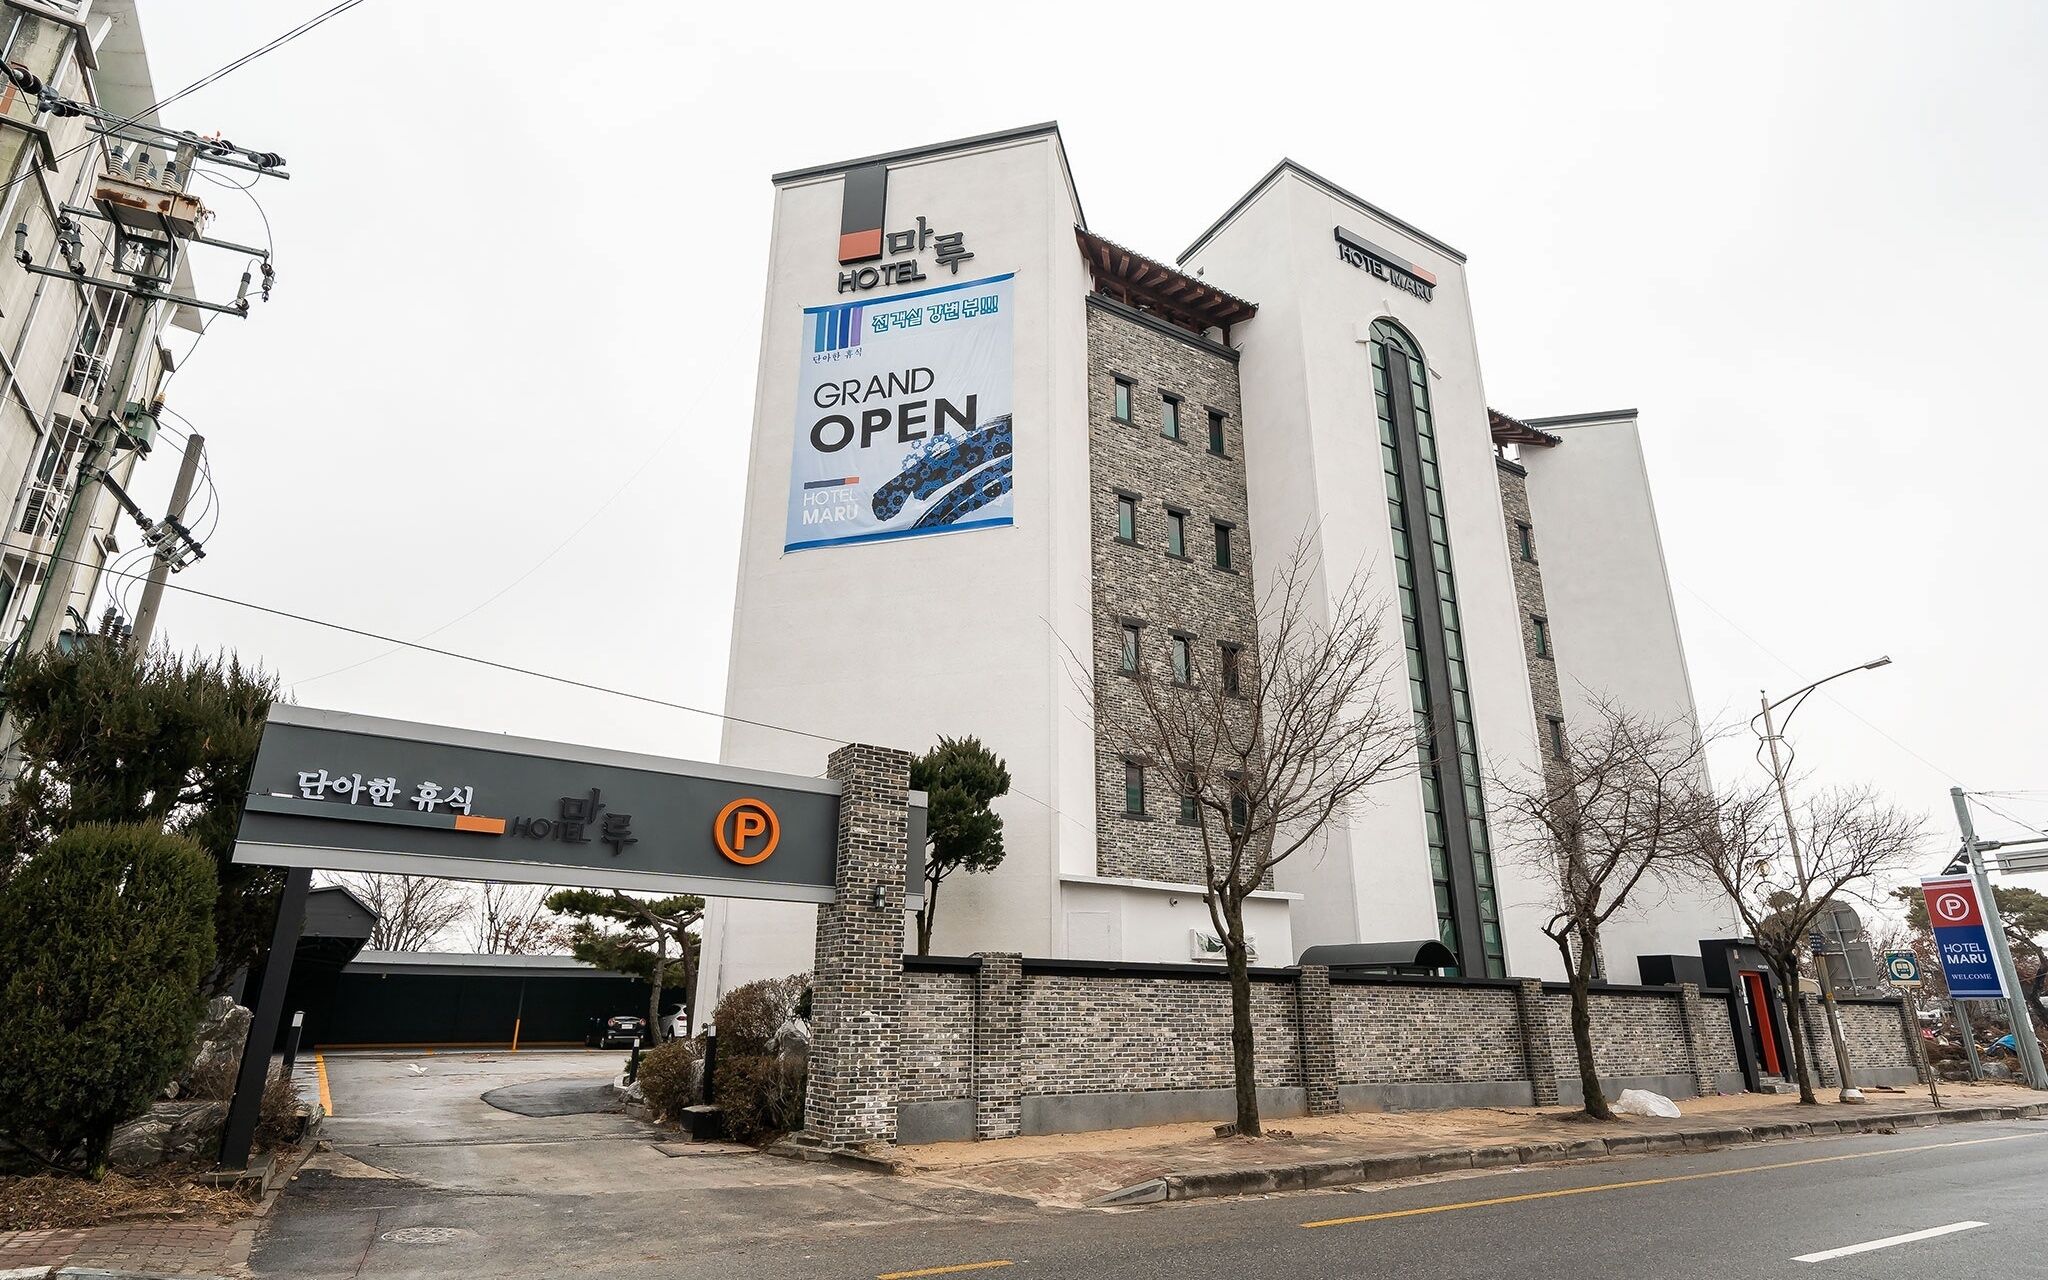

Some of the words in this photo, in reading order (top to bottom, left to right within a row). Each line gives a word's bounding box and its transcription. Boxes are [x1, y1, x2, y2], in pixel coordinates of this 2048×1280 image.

[886, 215, 974, 275] 마루
[837, 258, 927, 294] HOTEL
[1336, 242, 1390, 283] HOTEL
[1388, 268, 1434, 304] MARU
[813, 367, 935, 409] GRAND
[809, 394, 978, 453] OPEN
[802, 503, 859, 526] MARU
[803, 488, 856, 507] HOTEL
[298, 769, 401, 808] 단아한
[410, 780, 475, 816] 휴식
[512, 816, 592, 843] HOTEL
[559, 787, 639, 857] 마루
[734, 811, 767, 852] P
[1945, 899, 1961, 916] P
[1943, 943, 1985, 953] HOTEL
[1946, 953, 1988, 965] MARU
[1951, 973, 1993, 981] WELCOME
